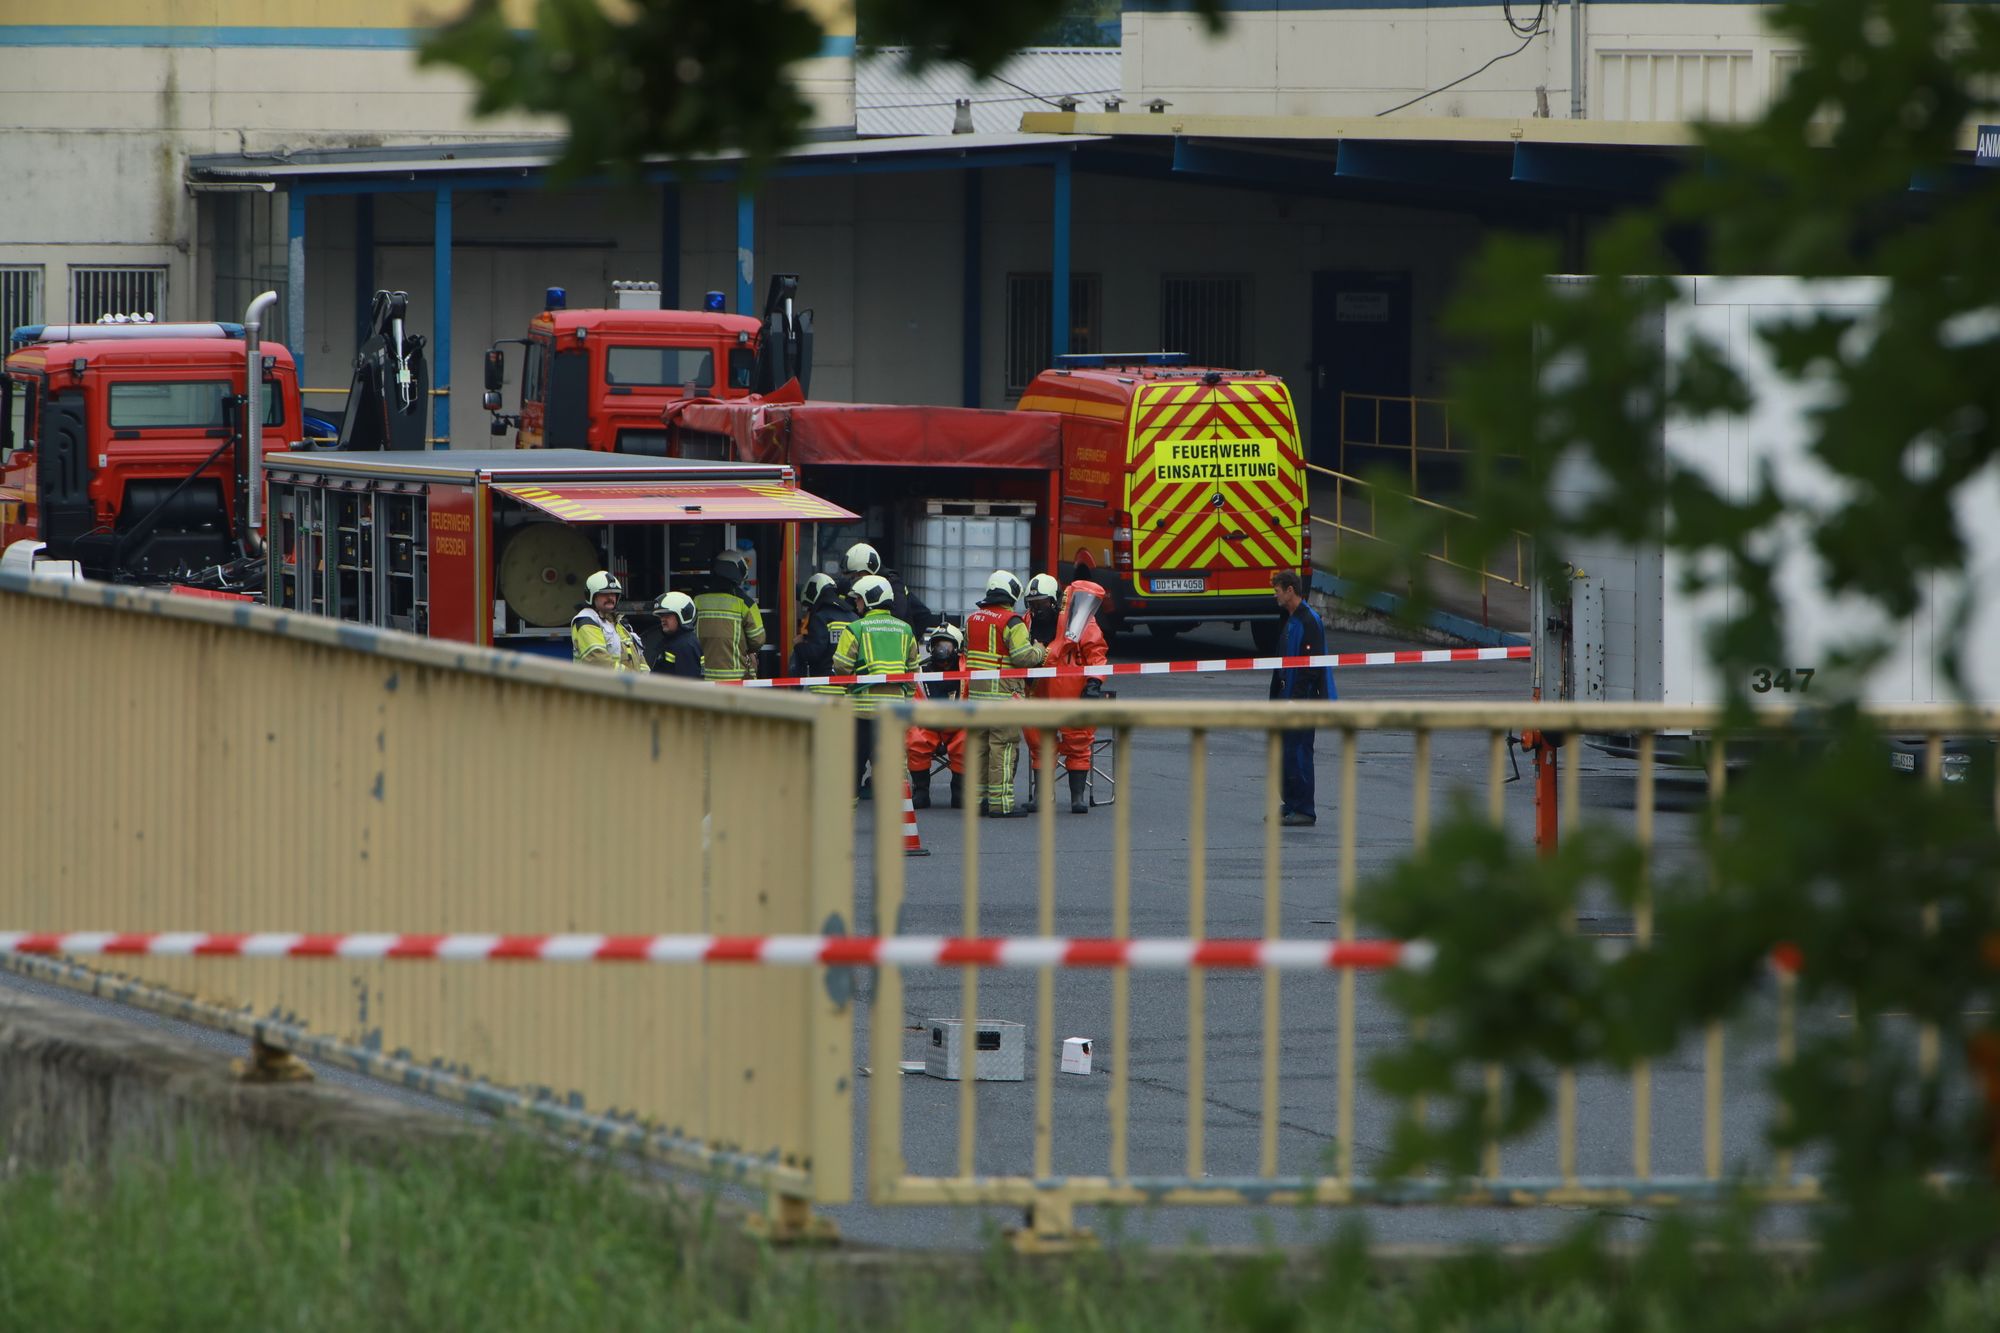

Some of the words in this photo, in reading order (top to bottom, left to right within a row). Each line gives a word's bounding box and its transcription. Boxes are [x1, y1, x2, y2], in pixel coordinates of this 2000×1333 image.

[1076, 447, 1108, 464] FEUERWEHR
[1172, 443, 1261, 459] FEUERWEHR
[1157, 462, 1277, 479] EINSATZLEITUNG
[431, 511, 471, 532] FEUERWEHR
[436, 536, 467, 556] DRESDEN
[1752, 668, 1815, 693] 347
